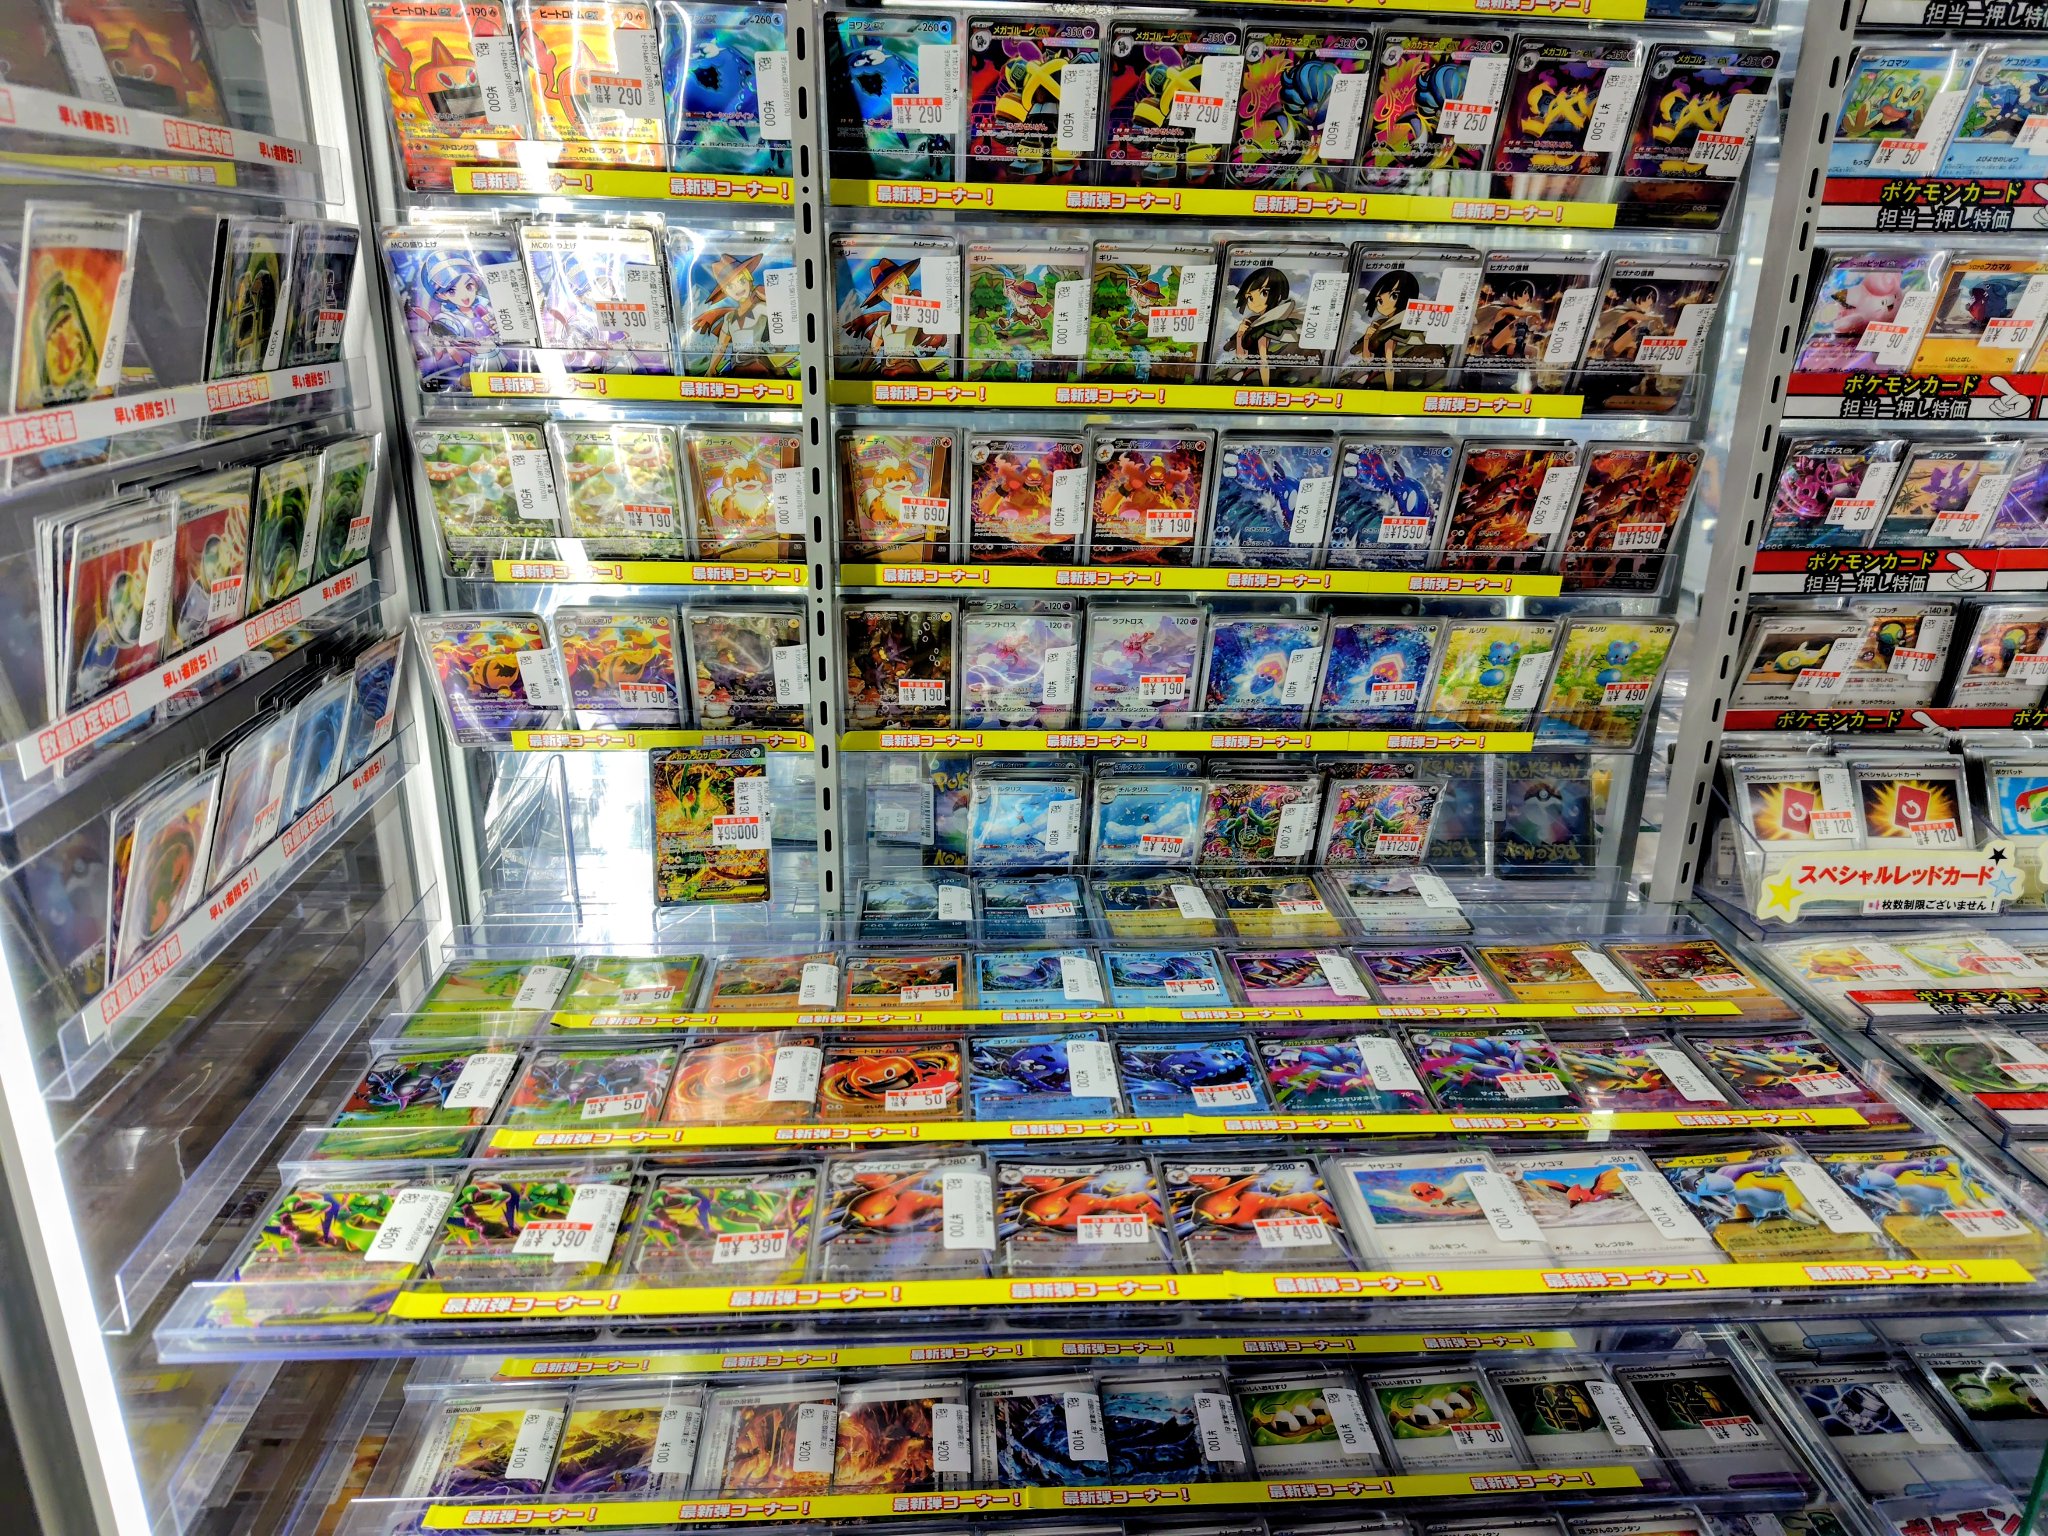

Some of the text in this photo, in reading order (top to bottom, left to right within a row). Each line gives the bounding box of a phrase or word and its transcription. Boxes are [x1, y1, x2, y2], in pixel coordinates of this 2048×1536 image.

[1925, 1, 2048, 28] 担当一押し特
[1881, 181, 2022, 204] ポケモンカード
[1844, 375, 1979, 395] ポケモンカード
[1807, 552, 1938, 571] ポケモンカード
[1776, 710, 1902, 729] ポケモンカード
[716, 823, 759, 842] ¥99000
[1799, 864, 1995, 886] スペシャルレッドカード
